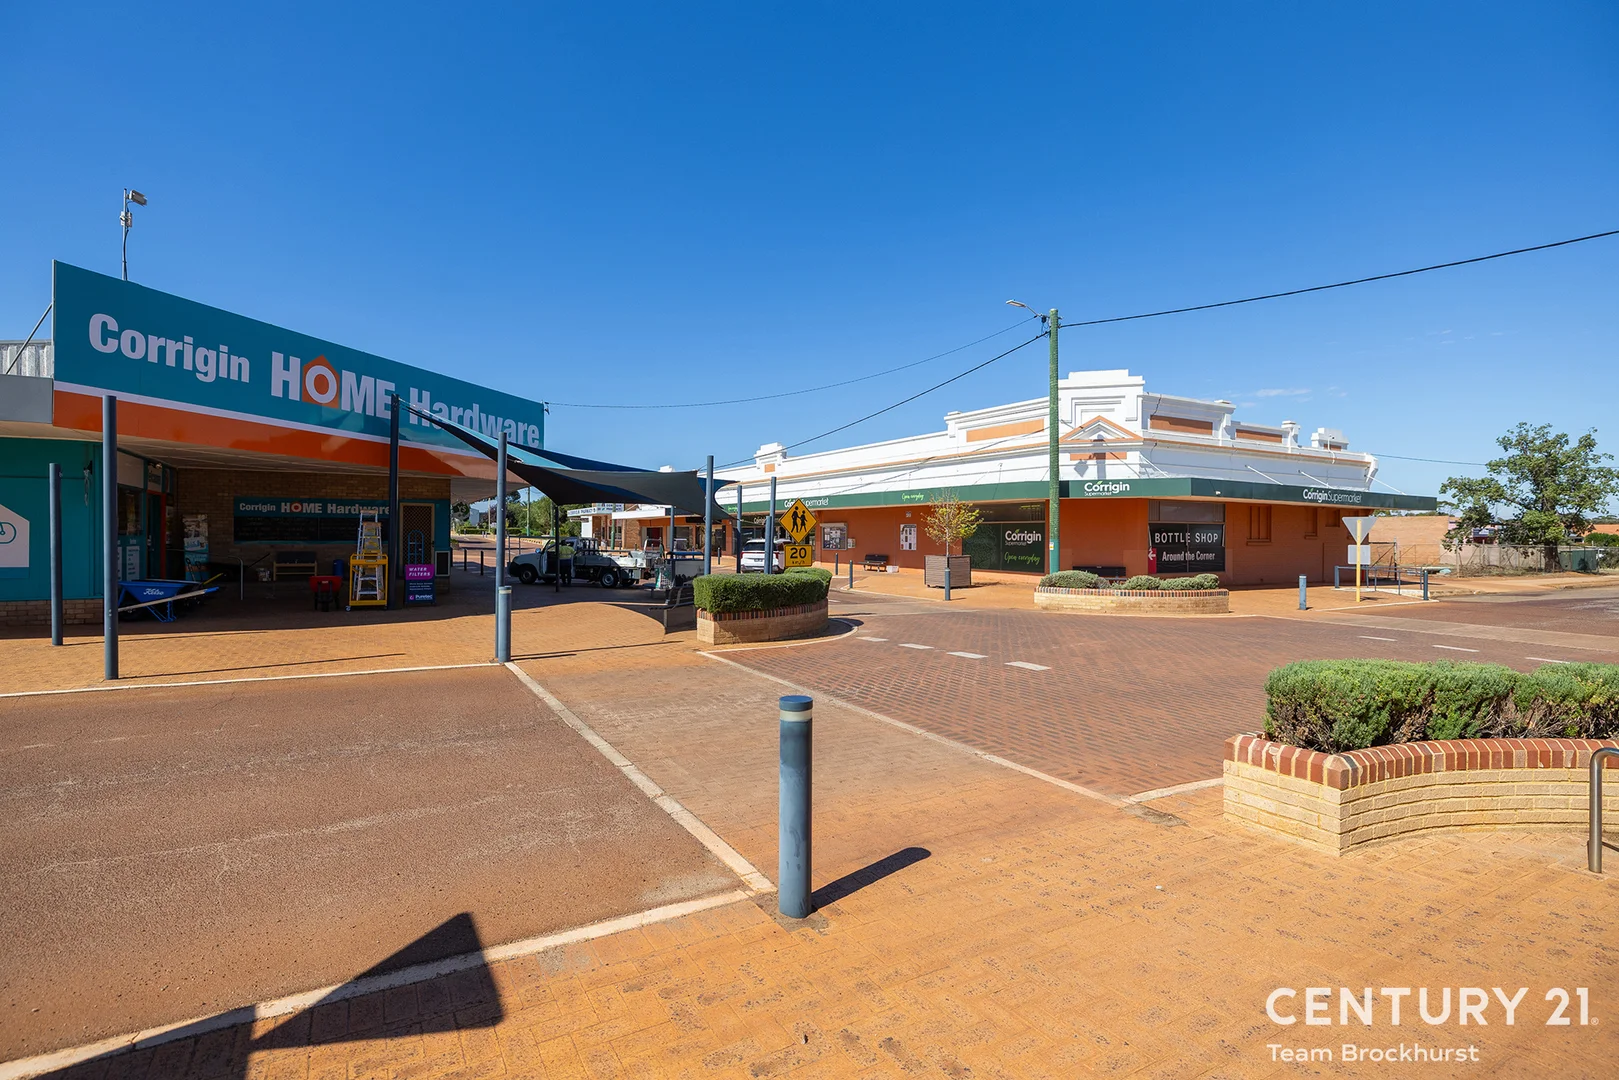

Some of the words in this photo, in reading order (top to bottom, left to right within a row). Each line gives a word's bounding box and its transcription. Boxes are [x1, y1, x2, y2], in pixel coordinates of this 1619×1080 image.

[88, 313, 250, 383] Corrigin
[270, 350, 396, 419] HOME
[409, 387, 540, 448] Hardware
[1084, 481, 1130, 494] Corrigin
[1303, 488, 1328, 502] Corrigin
[1328, 490, 1362, 503] Supermarket
[239, 503, 276, 513] Corrigin
[281, 502, 323, 514] HOME
[1005, 530, 1042, 544] Corrigin
[1154, 532, 1191, 543] BOTTLE
[1195, 532, 1218, 543] SHOP
[790, 547, 807, 559] 20
[1004, 551, 1017, 563] Open
[1018, 553, 1041, 566] everyday
[1162, 551, 1185, 561] Around
[1185, 551, 1195, 561] the
[1196, 550, 1216, 561] Corner
